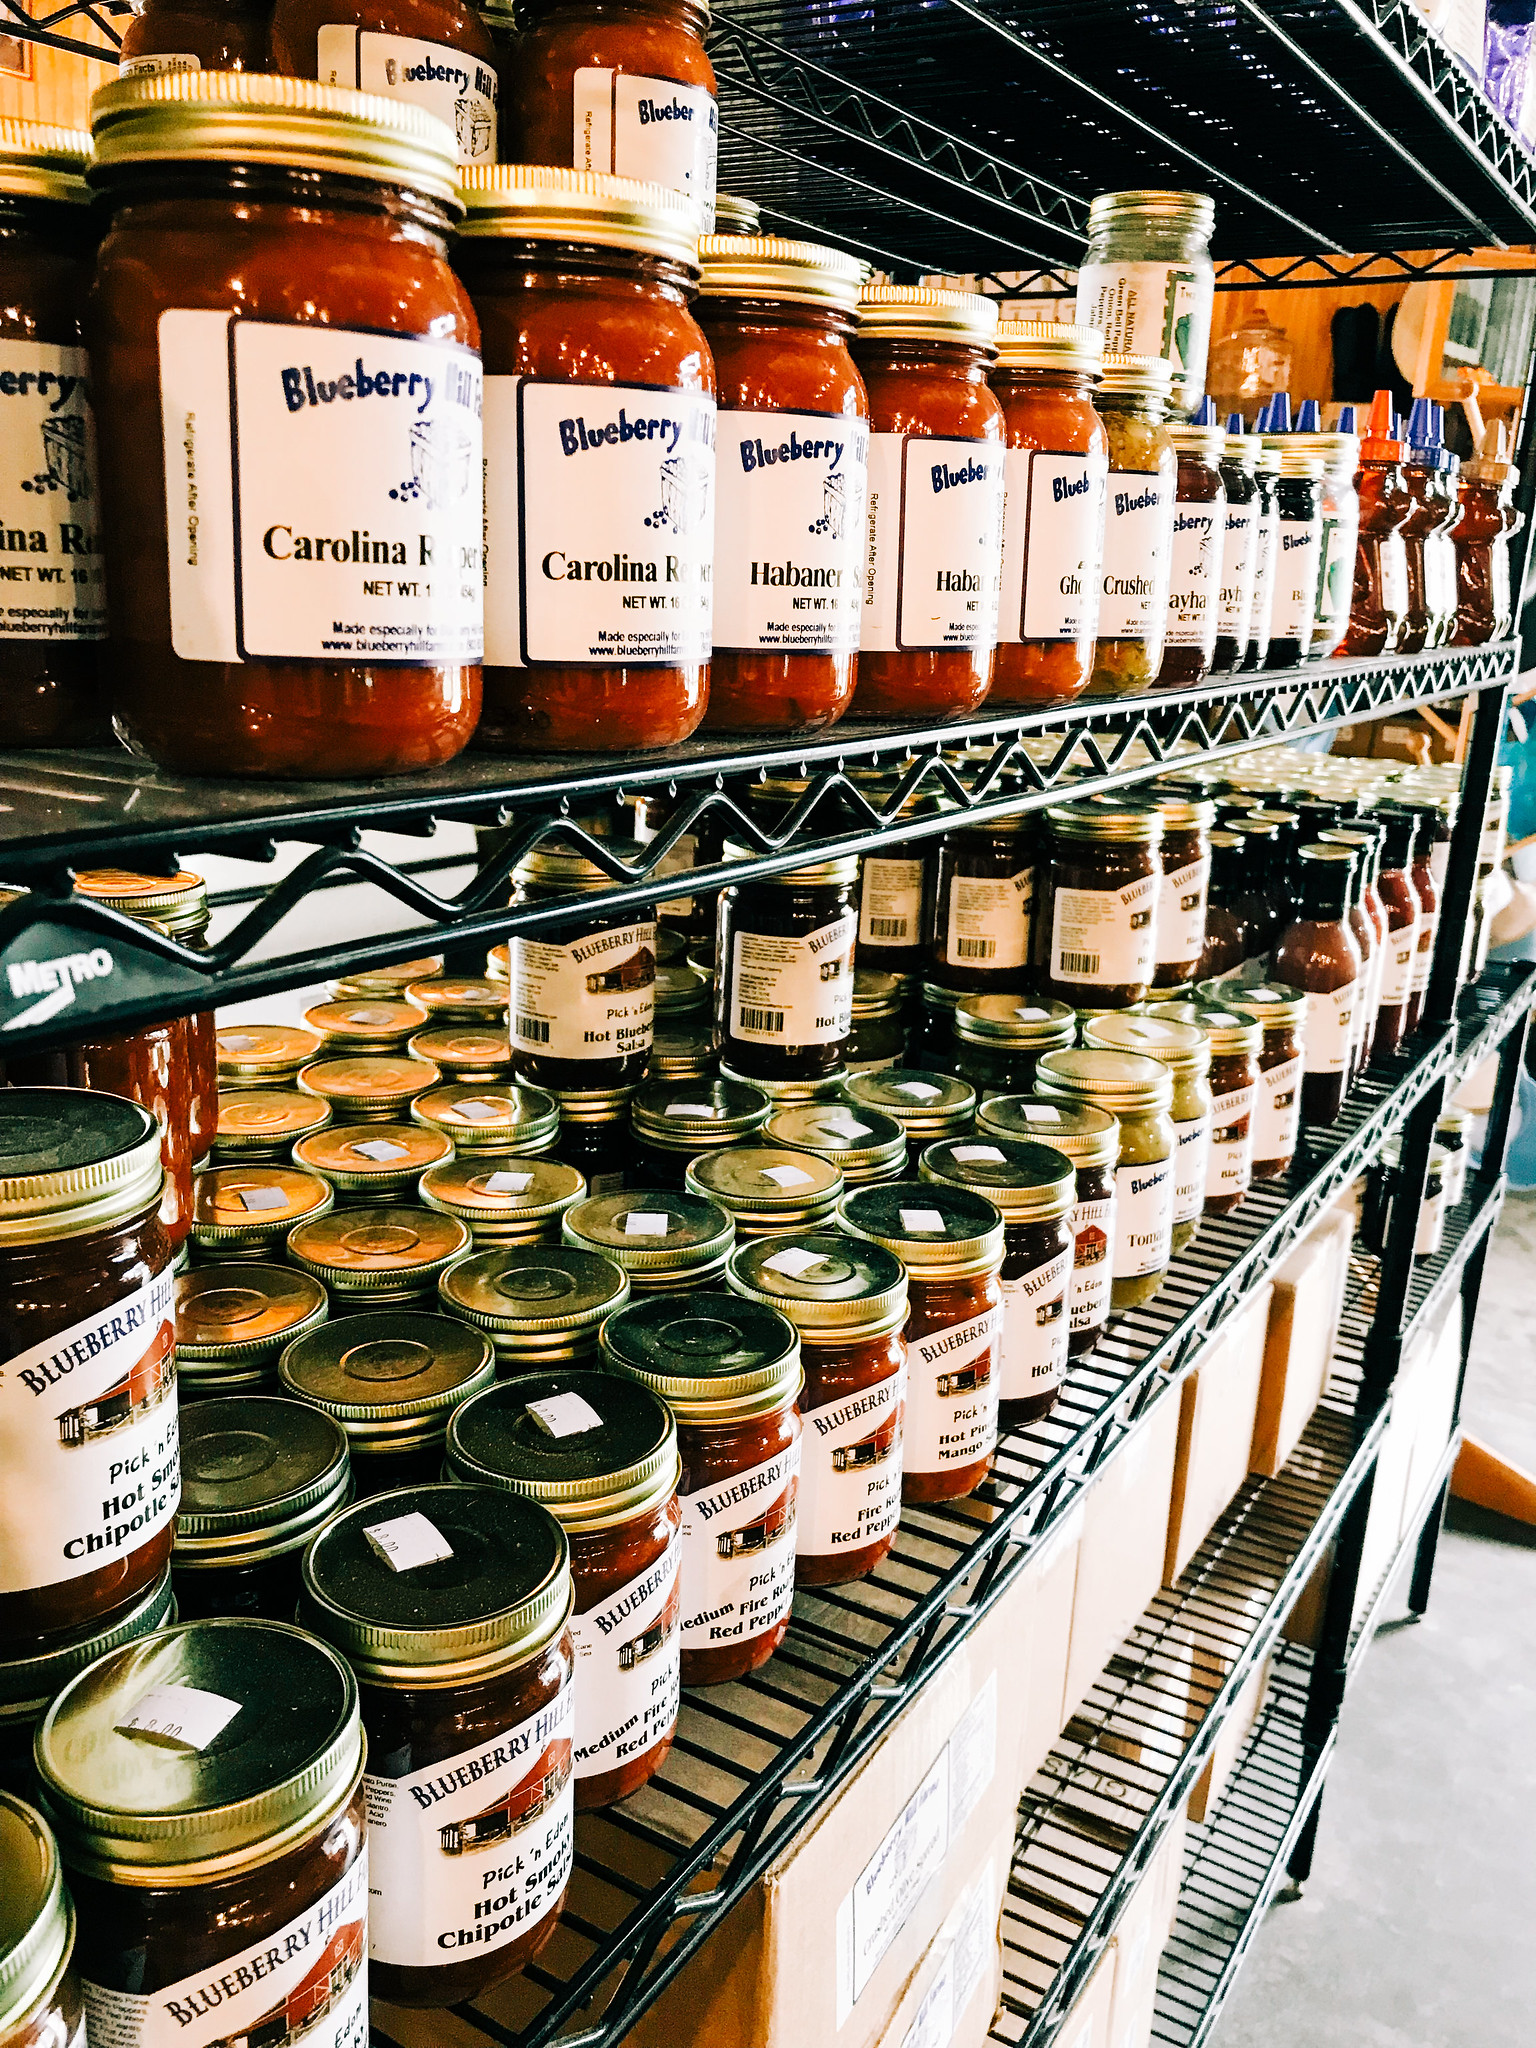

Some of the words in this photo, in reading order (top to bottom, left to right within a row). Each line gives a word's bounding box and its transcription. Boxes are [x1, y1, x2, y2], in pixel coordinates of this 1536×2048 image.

[385, 56, 470, 95] Bueberry
[638, 97, 695, 125] Blueber
[1123, 312, 1137, 353] NATURA
[281, 357, 433, 413] Blueberry
[183, 410, 196, 479] Refrigerate
[559, 408, 682, 456] Blueberry
[740, 431, 844, 473] Blueberry
[187, 483, 197, 513] After
[868, 493, 879, 542] Refrigerate
[187, 515, 199, 567] Opening
[263, 525, 407, 566] Carolina
[869, 545, 877, 567] After
[0, 567, 33, 581] NET
[542, 552, 657, 582] Carolina
[750, 561, 843, 588] Habaner
[363, 581, 393, 595] NET
[398, 582, 421, 597] WT.
[622, 596, 646, 608] NET
[650, 596, 667, 608] WT.
[865, 568, 877, 605] Opening
[793, 597, 812, 609] NET
[814, 598, 828, 609] WT.
[333, 621, 366, 635] Made
[369, 624, 422, 640] especially
[598, 631, 625, 642] Made
[627, 631, 669, 644] especially
[767, 622, 789, 632] Made
[792, 622, 826, 633] especially
[571, 931, 634, 964] BLUEBERRY
[5, 948, 113, 1012] METRO
[607, 1007, 629, 1020] Pick
[815, 1016, 835, 1028] Hot
[584, 1031, 611, 1043] Hot
[617, 1038, 645, 1053] Salsa
[1130, 1170, 1168, 1195] Blueberr
[17, 1298, 149, 1398] BLUEBERRY
[918, 1320, 989, 1364] BLUEBERRY
[1031, 1361, 1053, 1378] Hot
[812, 1386, 890, 1437] BLUEBERRY
[953, 1405, 978, 1423] Pick
[938, 1440, 983, 1460] Mango
[939, 1432, 965, 1445] Hot
[109, 1446, 150, 1485] Pick
[695, 1462, 782, 1521] BLUEBERRY
[867, 1475, 890, 1496] Pick
[102, 1483, 146, 1521] Hot
[857, 1504, 882, 1522] Fire
[63, 1494, 167, 1561] Chipotle
[831, 1528, 860, 1544] Red
[749, 1567, 776, 1591] Pick
[594, 1557, 674, 1636] BLUEBERRY
[680, 1602, 734, 1632] edium
[740, 1595, 768, 1616] Fire
[709, 1621, 743, 1640] Red
[651, 1663, 672, 1696] Pick
[574, 1714, 639, 1763] Medium
[643, 1697, 668, 1725] Fire
[616, 1731, 648, 1760] Red
[408, 1728, 532, 1809] BLUEBERRY
[369, 1809, 385, 1819] Acid
[482, 1855, 525, 1889] Pick
[474, 1887, 518, 1919] Hot
[437, 1892, 542, 1950] Chipotle
[163, 1920, 313, 2028] BLUEBERRY
[317, 1887, 355, 1936] HILL
